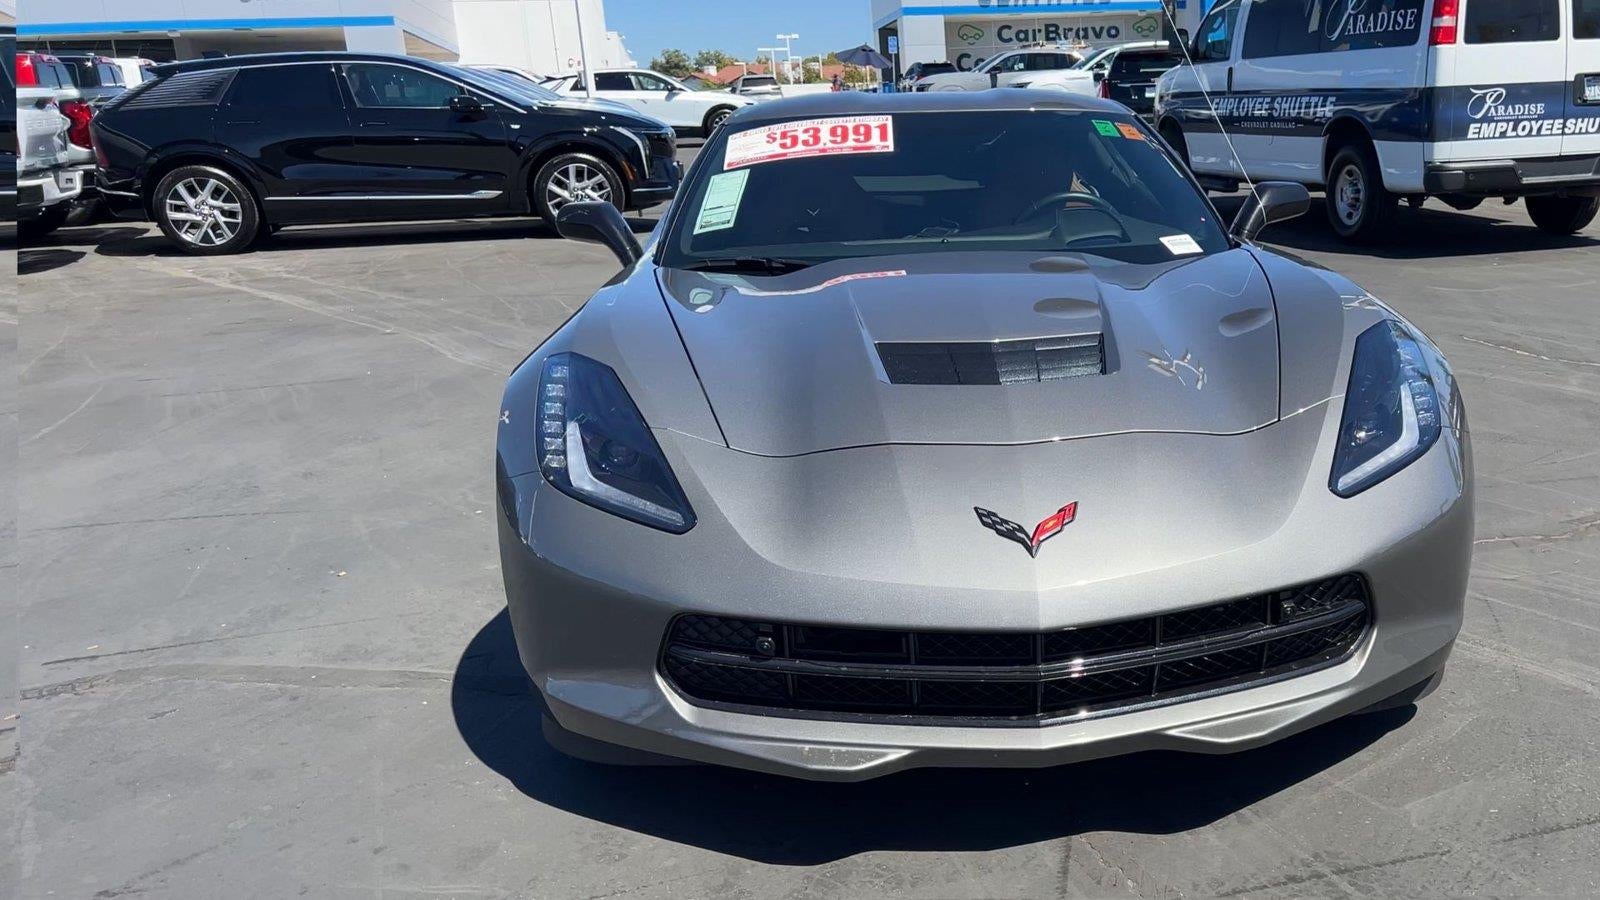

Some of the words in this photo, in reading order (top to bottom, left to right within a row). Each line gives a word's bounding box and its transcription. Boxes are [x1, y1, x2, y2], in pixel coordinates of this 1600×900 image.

[997, 23, 1120, 43] CarBravo
[1211, 97, 1271, 116] EMPLOYEE
[1272, 96, 1336, 117] SHUTTLE
[1467, 87, 1545, 118] PARADISE
[766, 122, 889, 149] $53,991
[1467, 122, 1563, 139] EMPLOYEE
[1564, 117, 1600, 134] SHU
